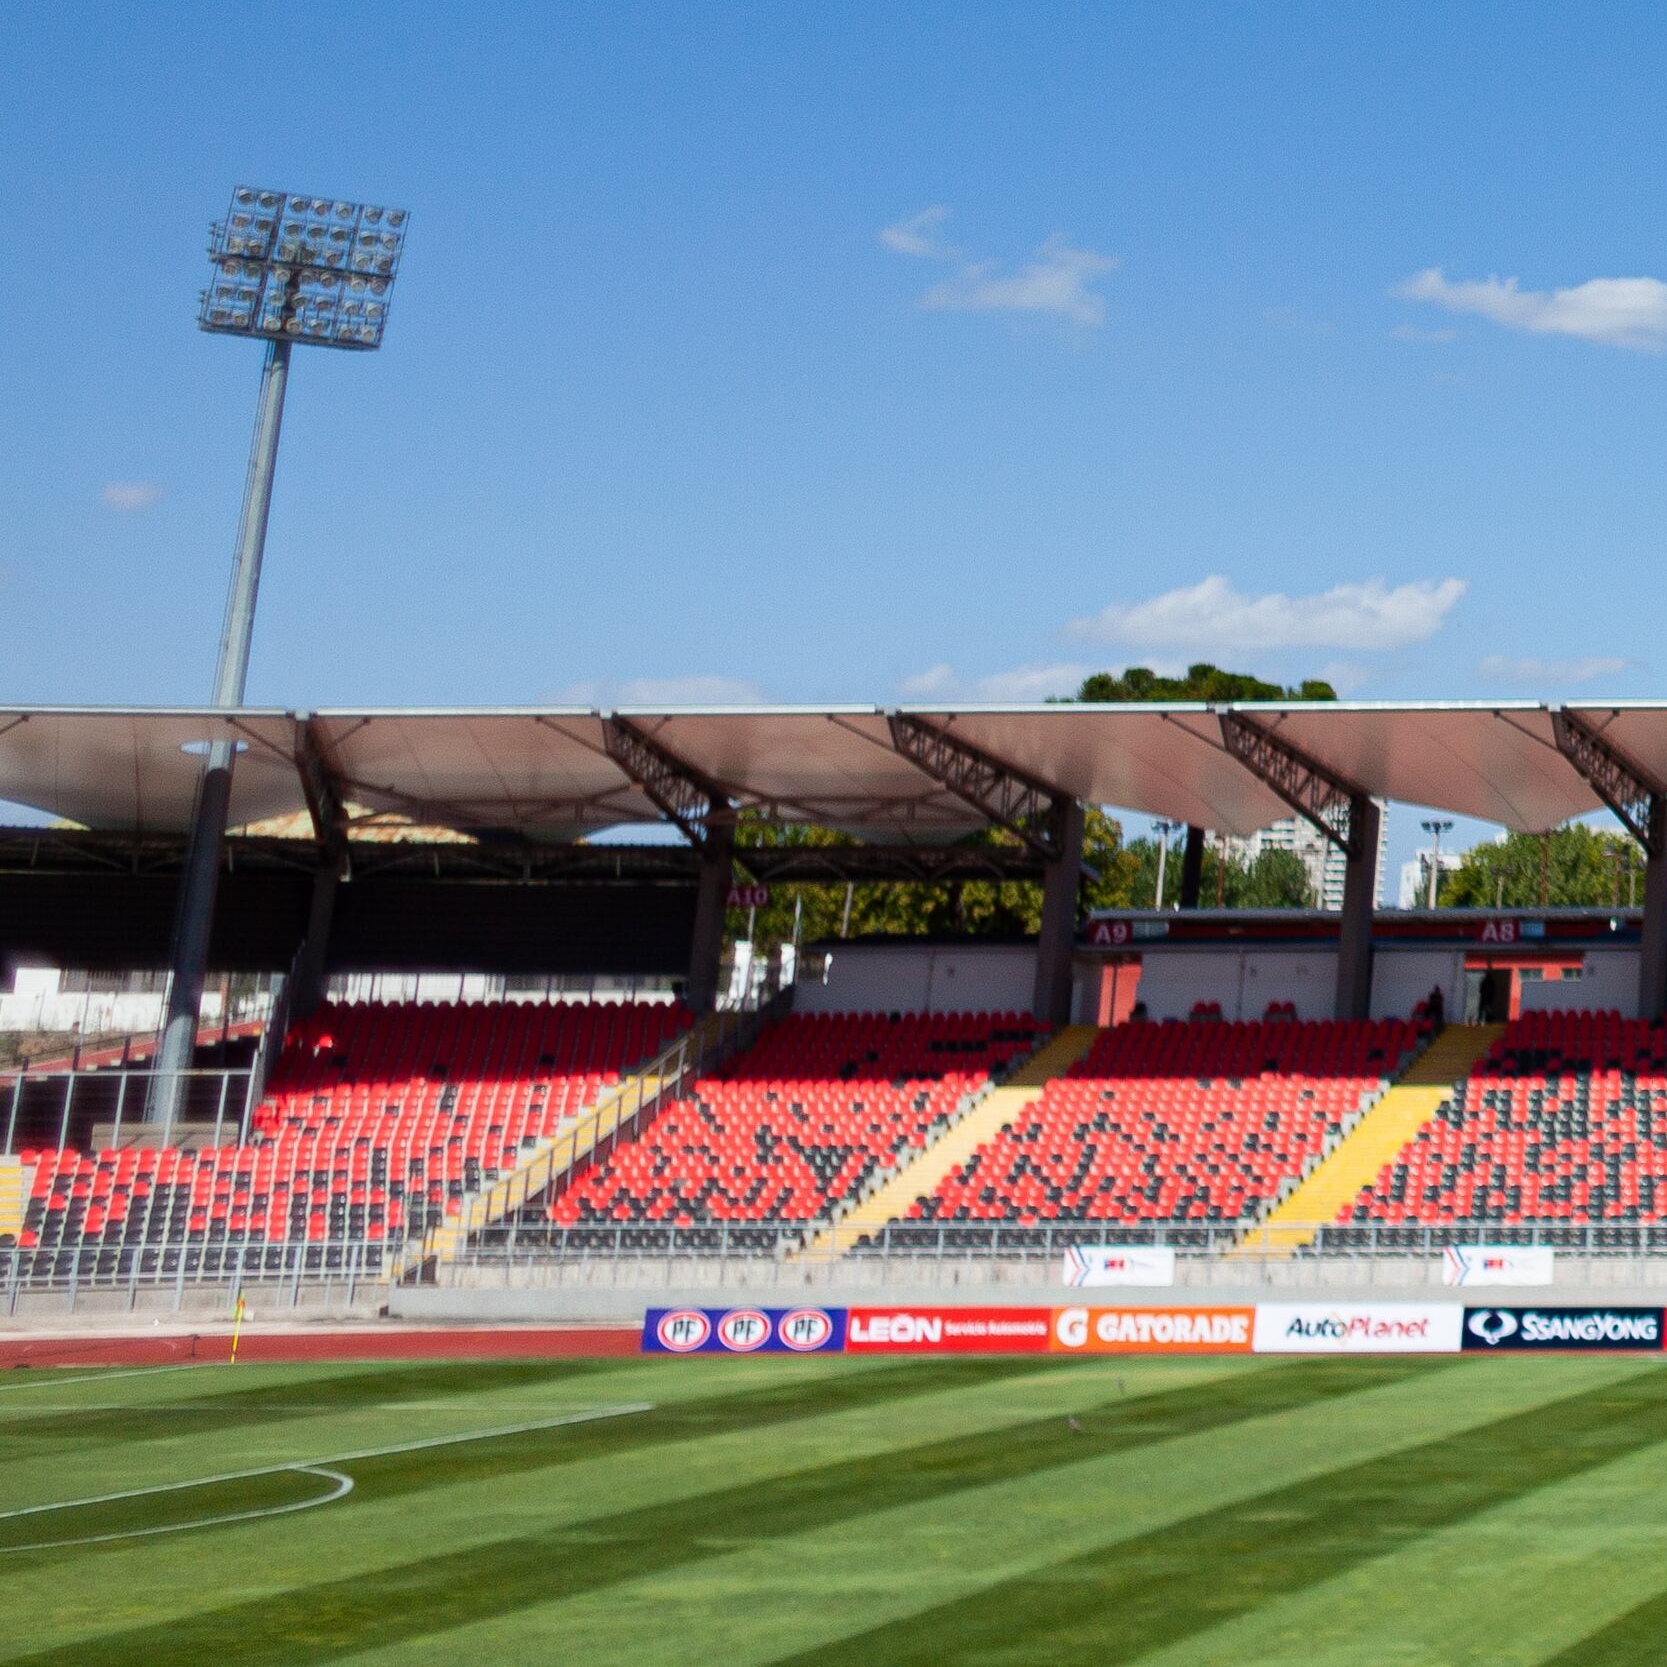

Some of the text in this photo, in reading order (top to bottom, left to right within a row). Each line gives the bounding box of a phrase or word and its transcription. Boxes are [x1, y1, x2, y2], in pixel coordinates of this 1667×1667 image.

[727, 889, 769, 905] A10
[1094, 922, 1128, 944] A9
[1481, 921, 1516, 942] A8
[671, 1319, 697, 1343] PF
[732, 1319, 758, 1343] PF
[793, 1318, 818, 1342] PF
[1056, 1309, 1250, 1347] G GATORADE
[1286, 1316, 1431, 1340] AutoPlanet
